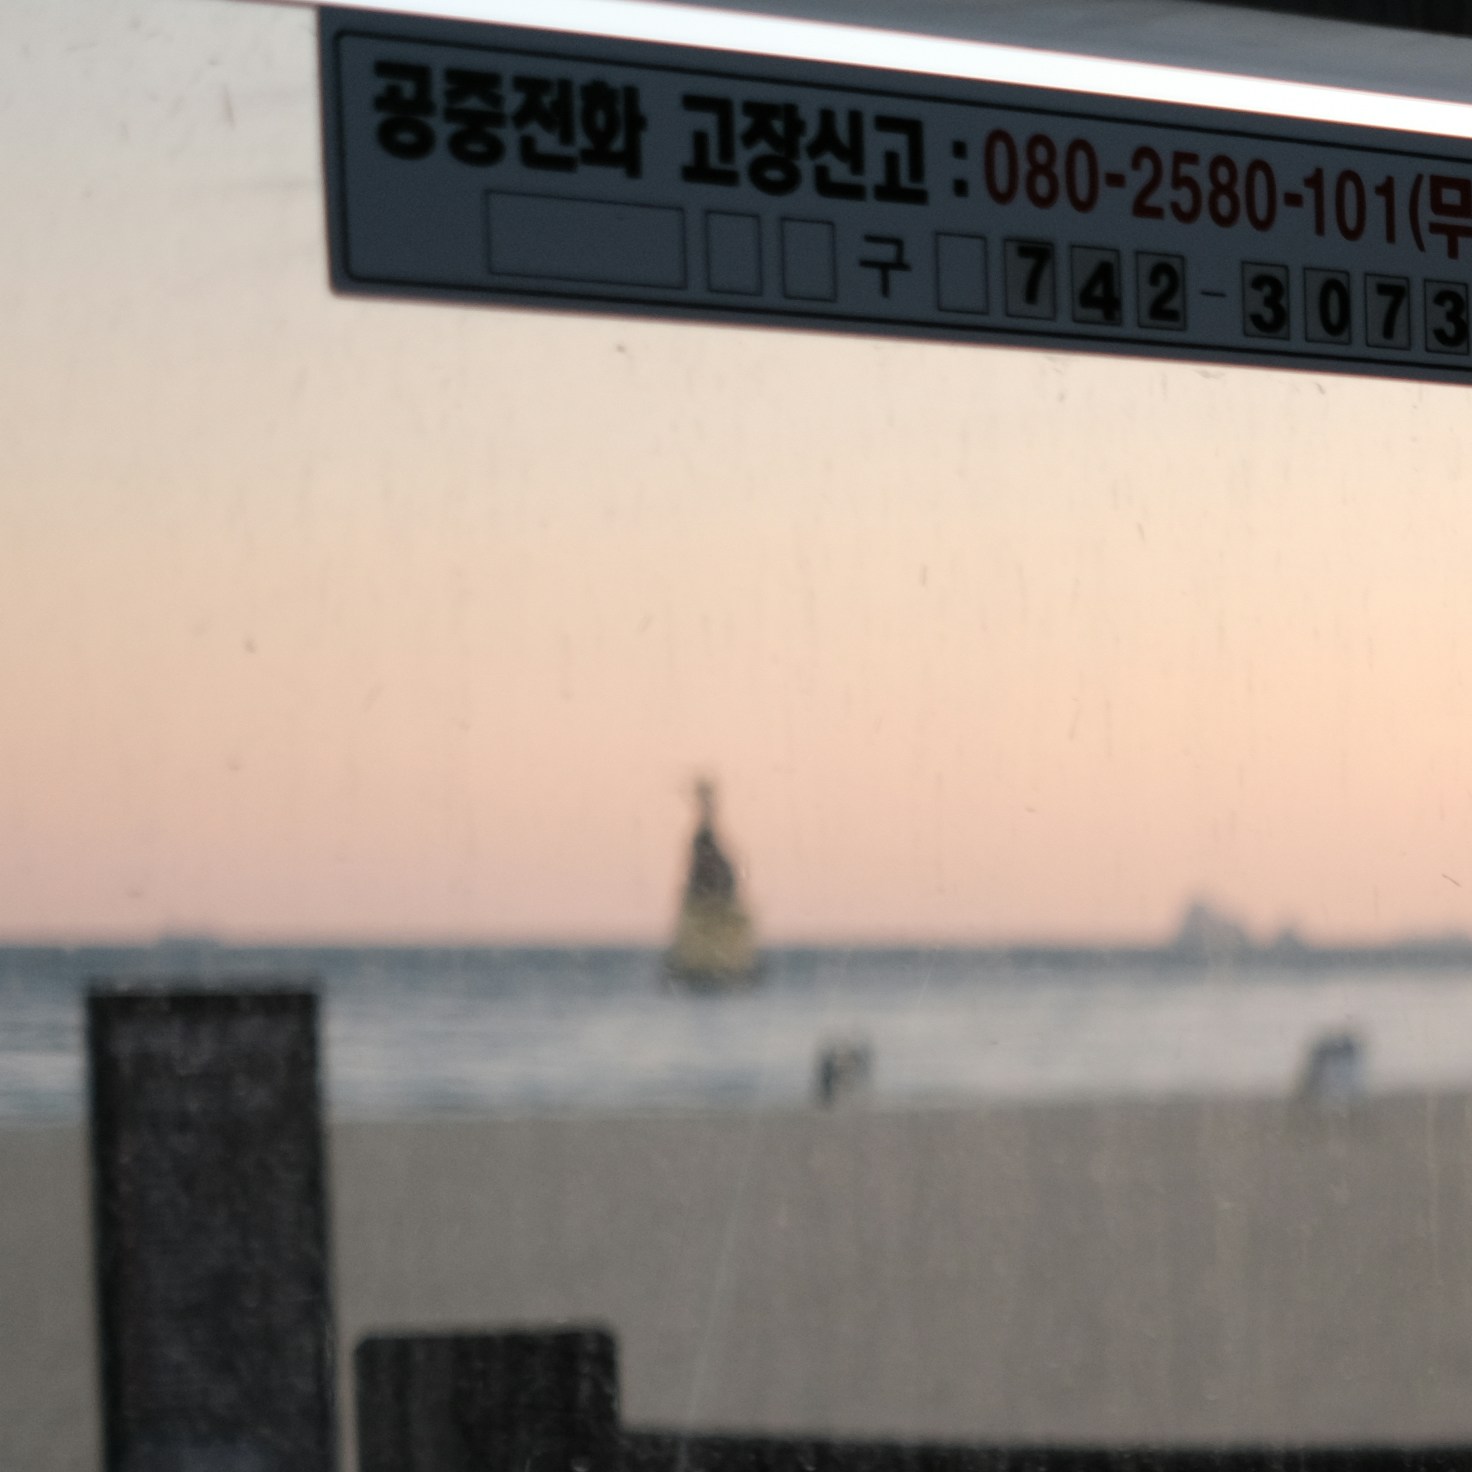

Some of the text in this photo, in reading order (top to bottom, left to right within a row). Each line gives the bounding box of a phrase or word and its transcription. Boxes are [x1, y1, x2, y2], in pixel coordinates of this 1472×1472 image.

[372, 59, 650, 180] 공중전화
[680, 93, 930, 207] 고장신고
[857, 233, 913, 299] 구
